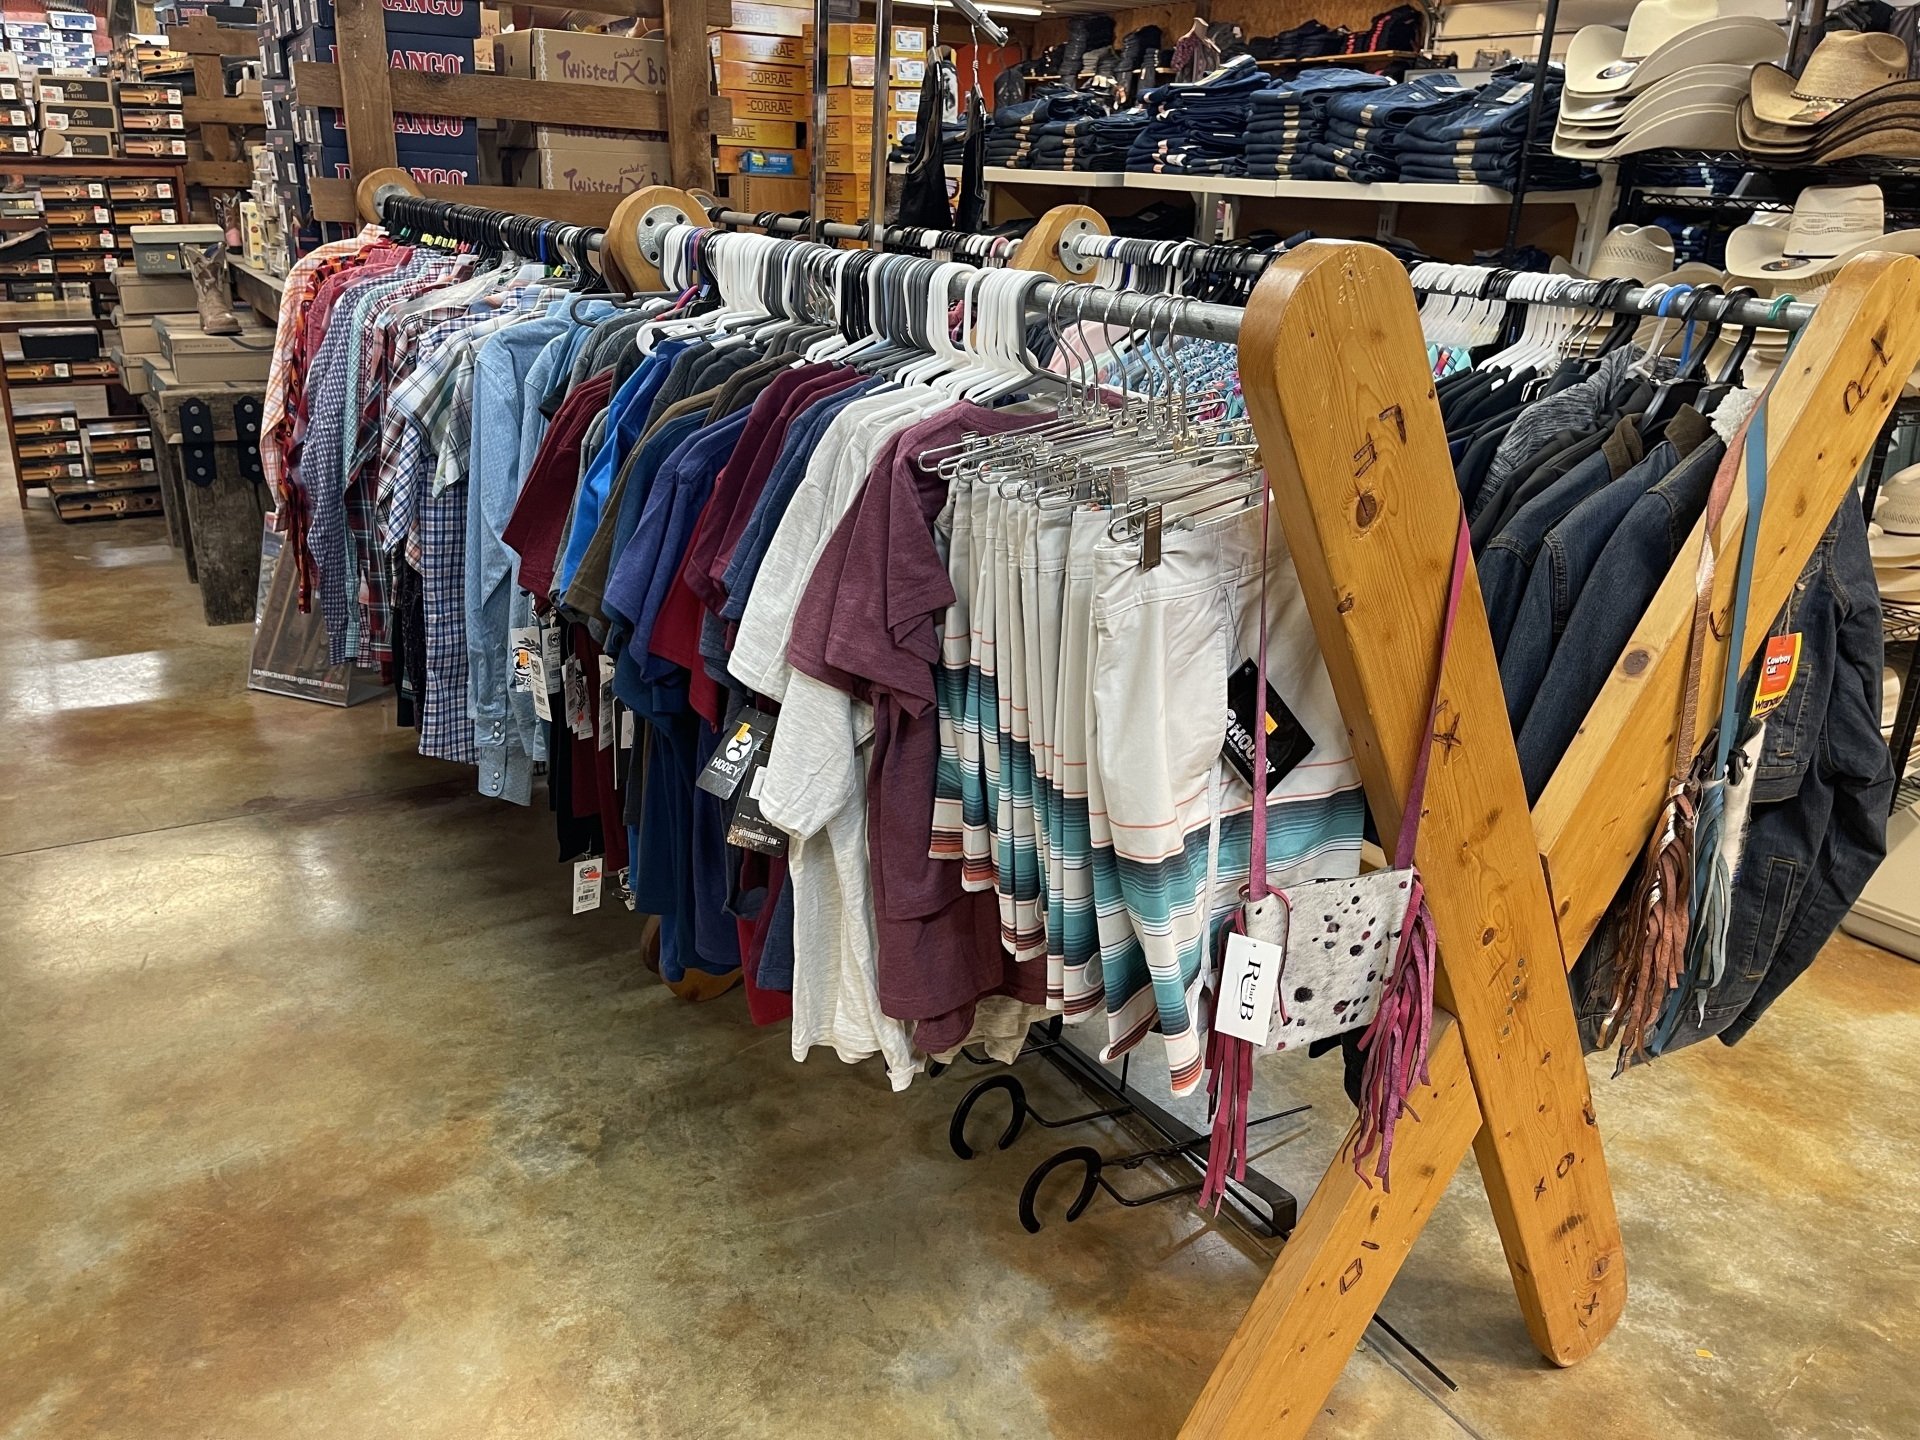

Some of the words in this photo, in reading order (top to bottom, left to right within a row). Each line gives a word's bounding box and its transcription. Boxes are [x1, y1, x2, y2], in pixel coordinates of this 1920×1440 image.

[556, 49, 618, 83] Twisted
[619, 59, 645, 85] X
[750, 70, 791, 86] CORRAL
[750, 99, 791, 113] CORRAL
[1766, 655, 1792, 666] Cowboy
[1766, 666, 1778, 676] Cut
[711, 757, 742, 778] HOOEY
[1240, 1001, 1255, 1021] B
